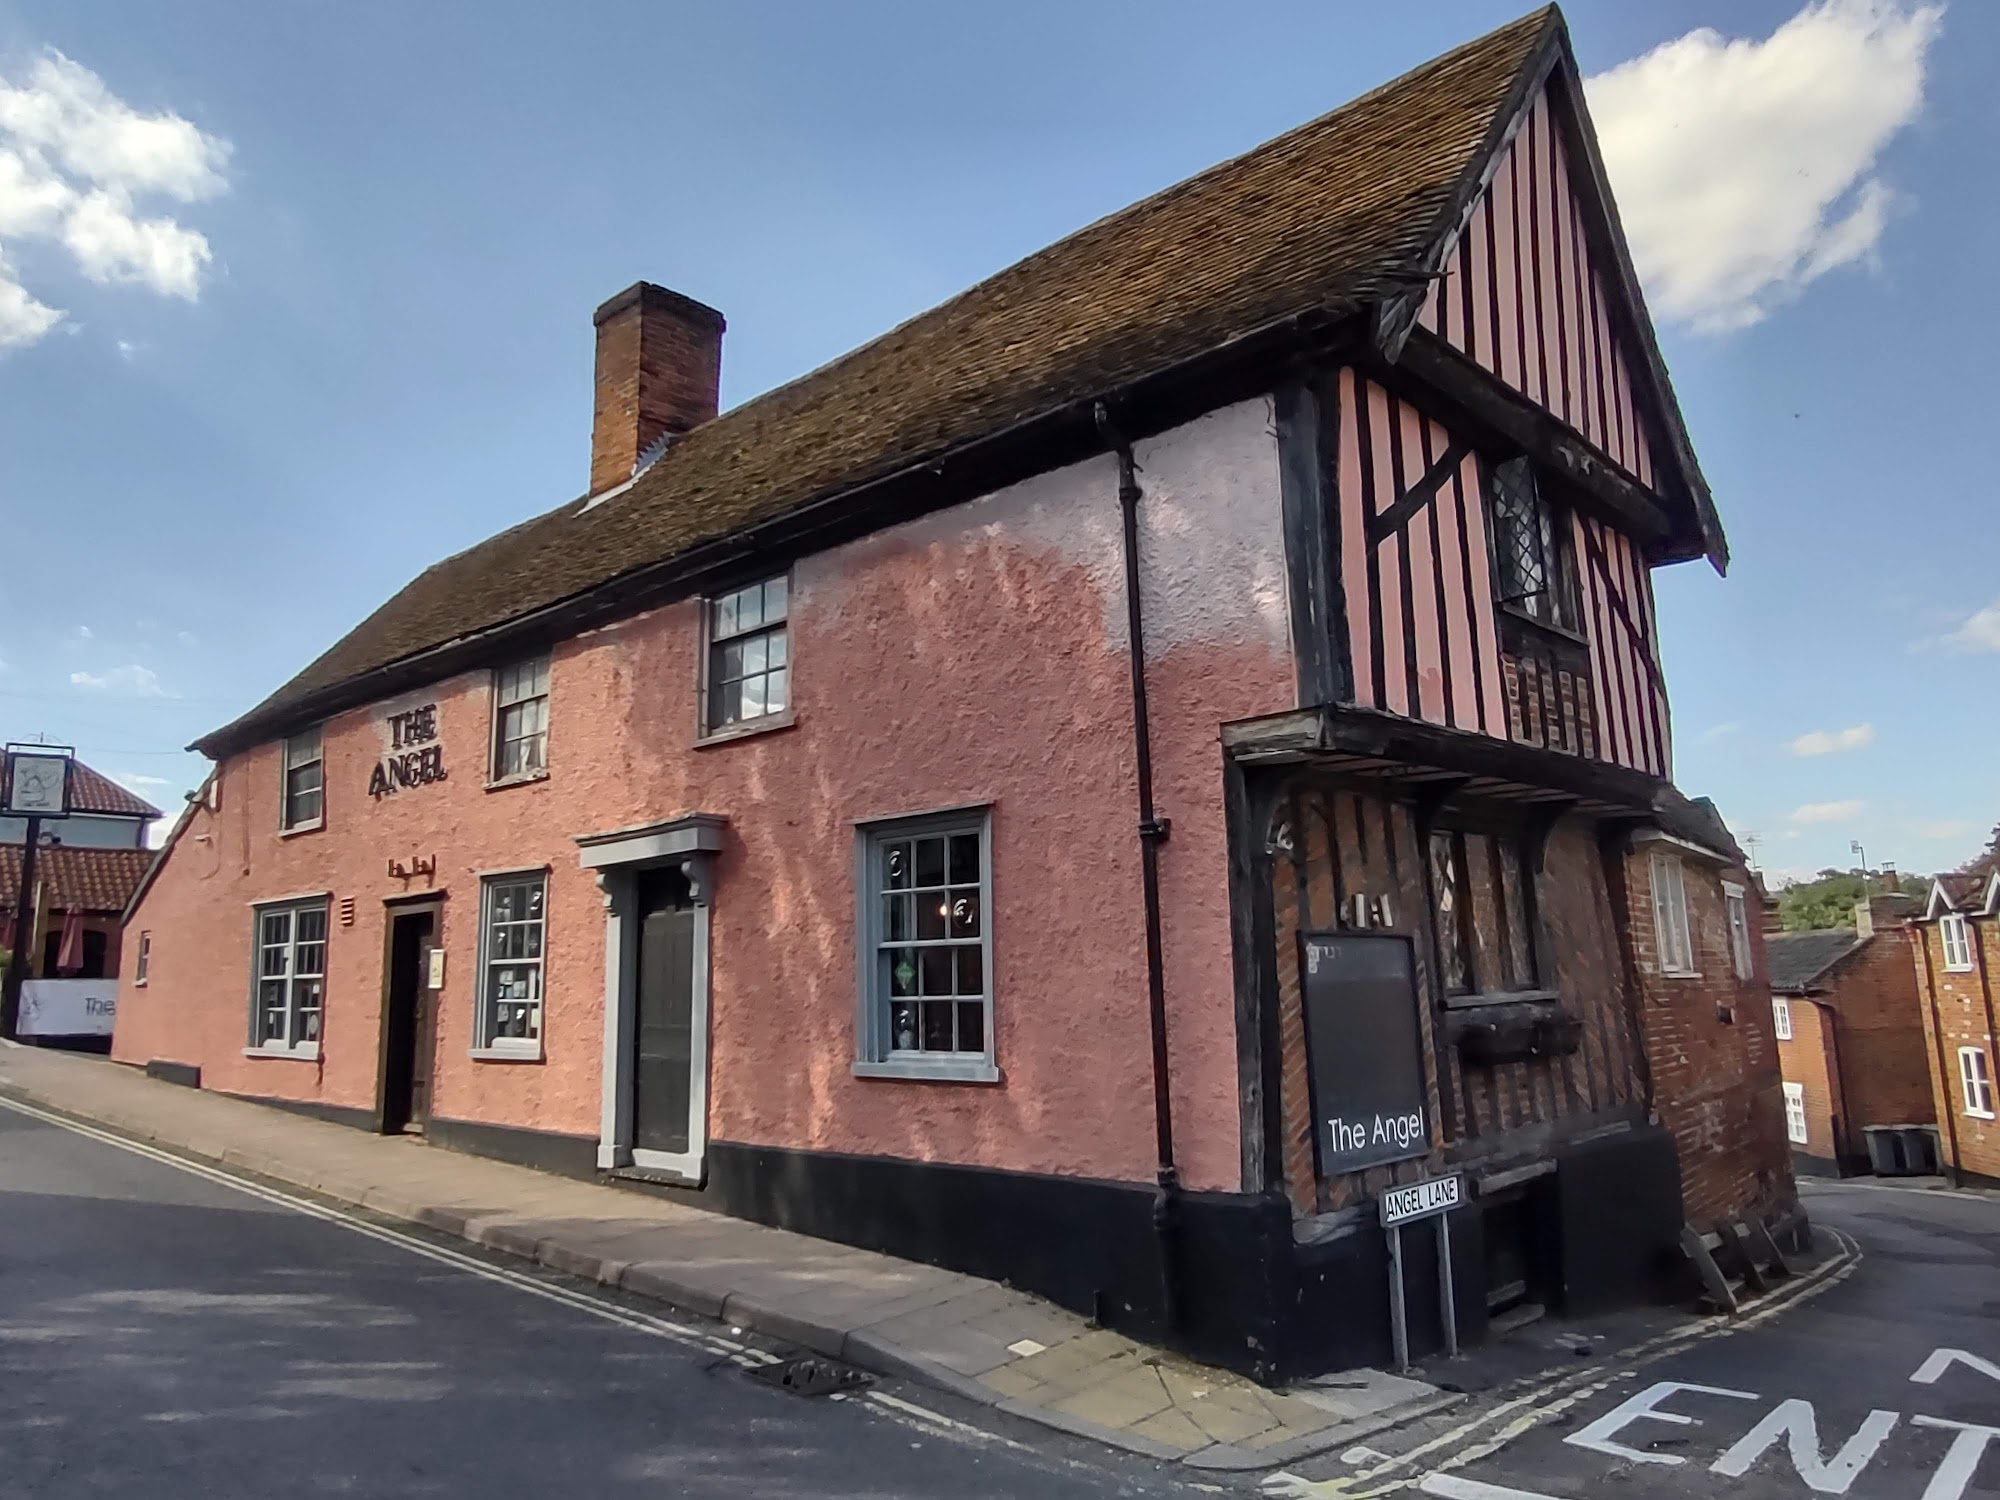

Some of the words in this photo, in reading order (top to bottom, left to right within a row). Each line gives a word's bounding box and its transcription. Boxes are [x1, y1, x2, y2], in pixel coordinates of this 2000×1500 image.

[386, 703, 437, 749] THE
[368, 744, 448, 796] ANGEL
[85, 997, 116, 1016] The
[1328, 1117, 1366, 1152] The
[1372, 1106, 1424, 1149] Angel
[1386, 1188, 1424, 1217] ANGEL
[1428, 1180, 1455, 1206] LANE
